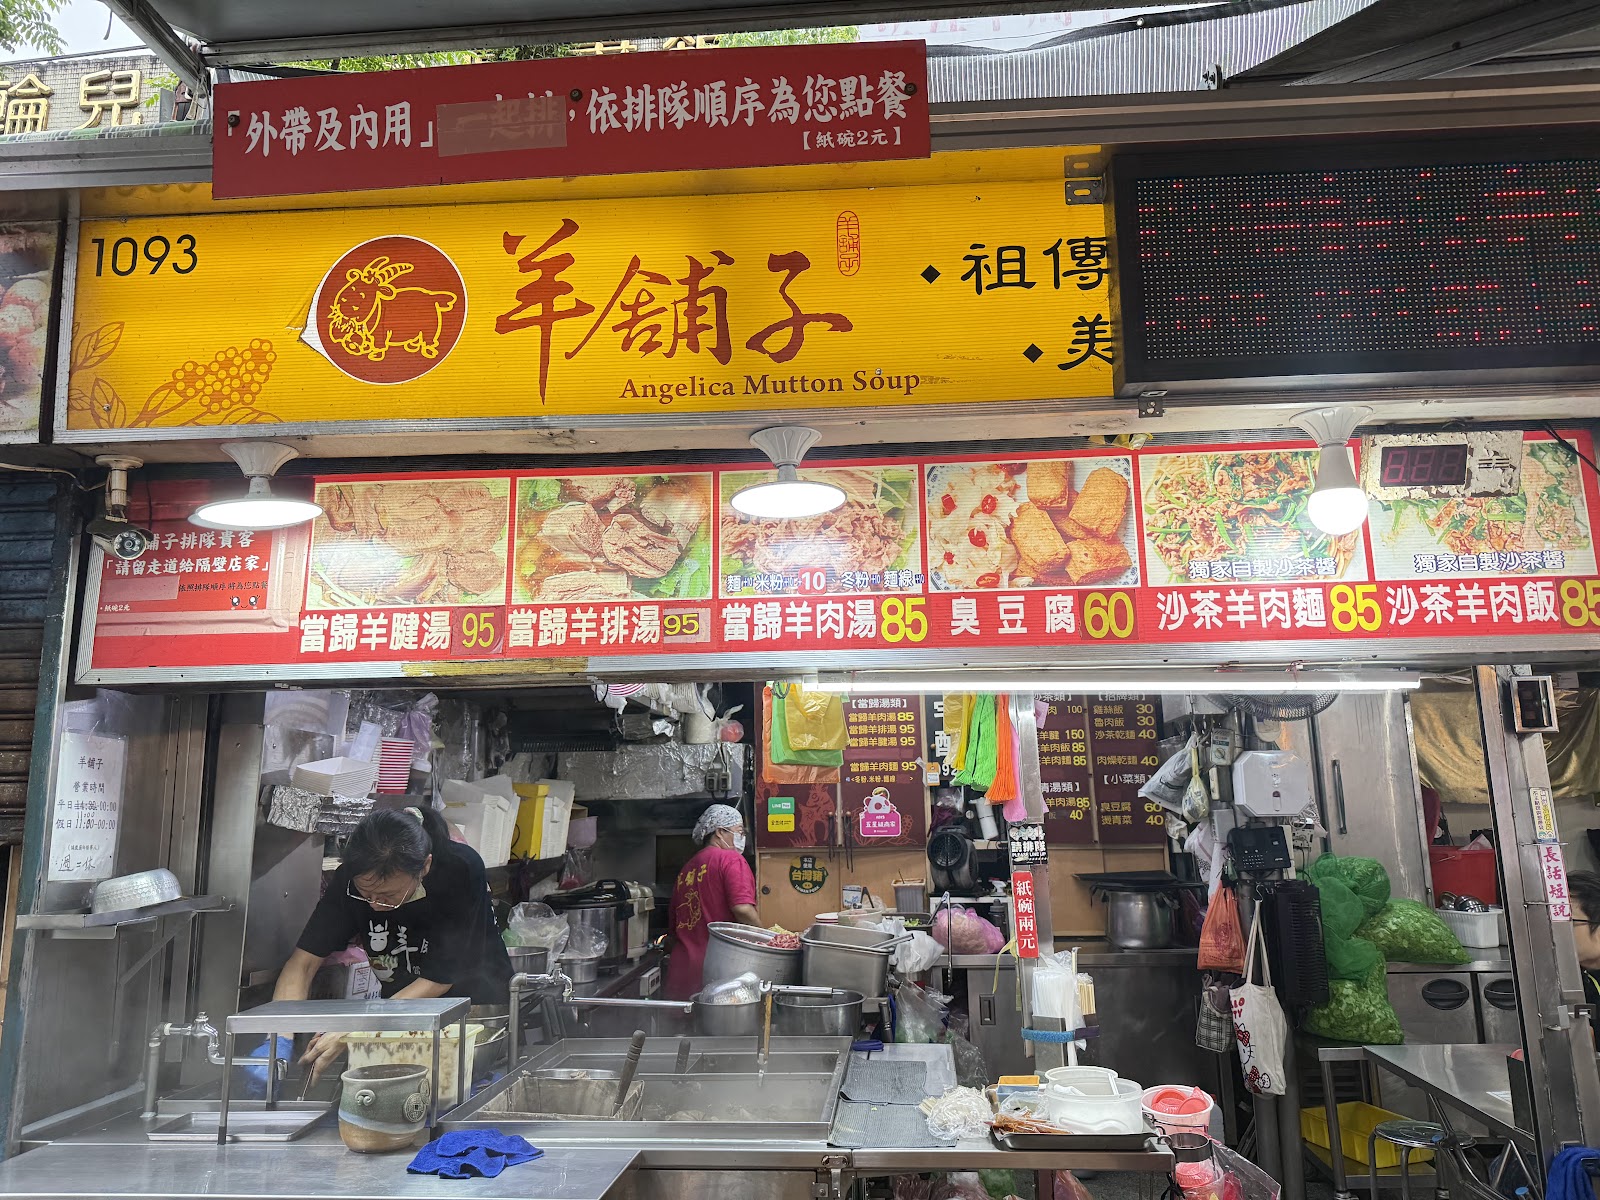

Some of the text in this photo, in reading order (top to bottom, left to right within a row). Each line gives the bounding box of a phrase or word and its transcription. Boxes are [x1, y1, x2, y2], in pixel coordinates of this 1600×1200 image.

[803, 129, 902, 151] 【紙碗2元】
[91, 233, 198, 278] 1093
[961, 236, 1110, 295] 祖傳
[495, 217, 853, 406] 羊舖子
[619, 370, 921, 405] Angelica Mutton Soup
[1189, 556, 1337, 579] 獨家自製沙茶醬
[1413, 550, 1565, 574] 獨家自製沙茶醬
[1156, 583, 1383, 632] 沙茶羊肉麵 85
[1386, 579, 1600, 627] 沙茶羊肉飯 85
[721, 597, 929, 643] 當歸羊肉湯 85
[1083, 591, 1134, 638] 60
[300, 610, 495, 654] 當歸羊腱湯 95
[507, 604, 700, 648] 當歸羊排湯 95
[1067, 705, 1083, 714] 100
[1136, 703, 1154, 714] 30
[897, 711, 915, 722] 85
[1136, 716, 1155, 726] 30
[899, 724, 915, 734] 95
[1065, 729, 1085, 740] 150
[1138, 728, 1157, 740] 40
[900, 736, 916, 746] 95
[1038, 742, 1086, 753] 羊肉飯 85
[901, 761, 917, 771] 95
[1039, 755, 1087, 766] 羊肉麵 85
[1140, 755, 1159, 766] 40
[1076, 797, 1090, 808] 85
[1144, 802, 1162, 813] 60
[1069, 809, 1083, 820] 40
[1145, 814, 1164, 826] 40
[1543, 845, 1571, 919] 長話短說
[1015, 880, 1036, 950] 紙碗兩元
